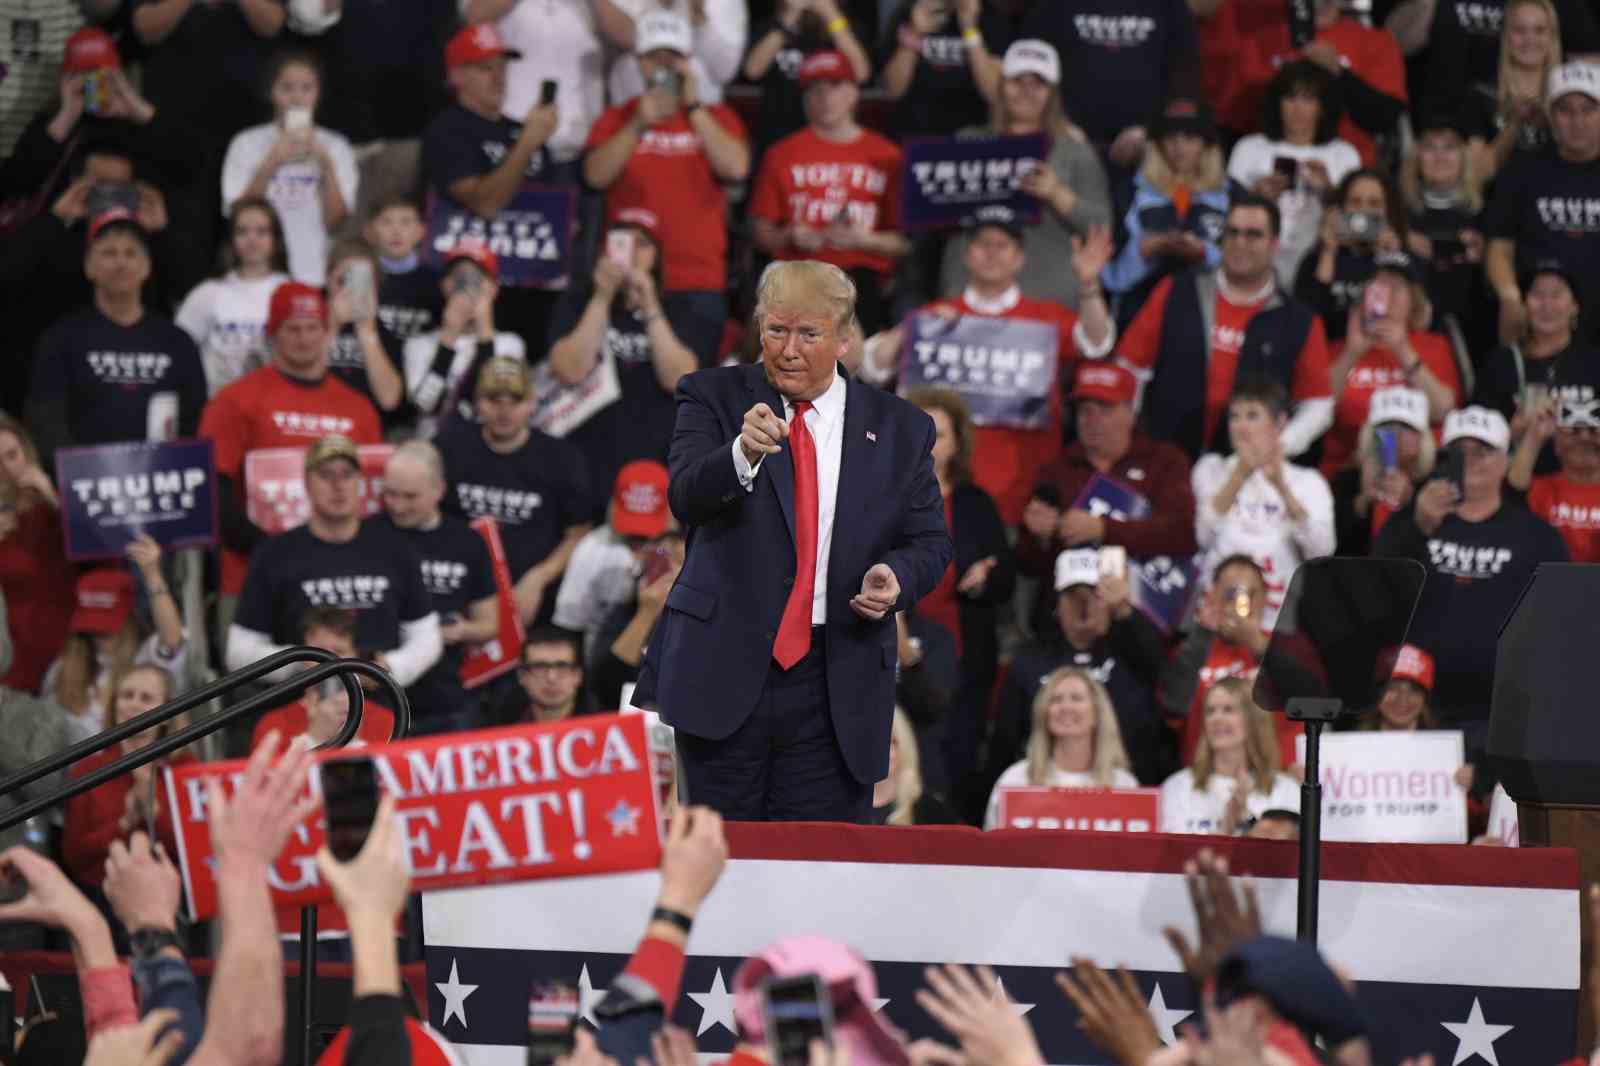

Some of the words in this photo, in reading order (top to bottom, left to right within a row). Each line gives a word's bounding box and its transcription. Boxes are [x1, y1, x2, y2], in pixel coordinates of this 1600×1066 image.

[1075, 14, 1156, 31] TRUMP
[911, 157, 1036, 184] TRUMP
[87, 352, 172, 369] TRUMP
[913, 341, 1044, 371] TRUMP
[272, 411, 353, 432] TRUMP
[72, 468, 206, 503] TRUMP
[457, 482, 542, 509] TRUMP
[87, 492, 195, 518] PENCE
[1427, 539, 1511, 563] TRUMP
[302, 575, 389, 597] TRUMP
[1321, 766, 1451, 800] Women
[1375, 801, 1439, 817] TRUMP
